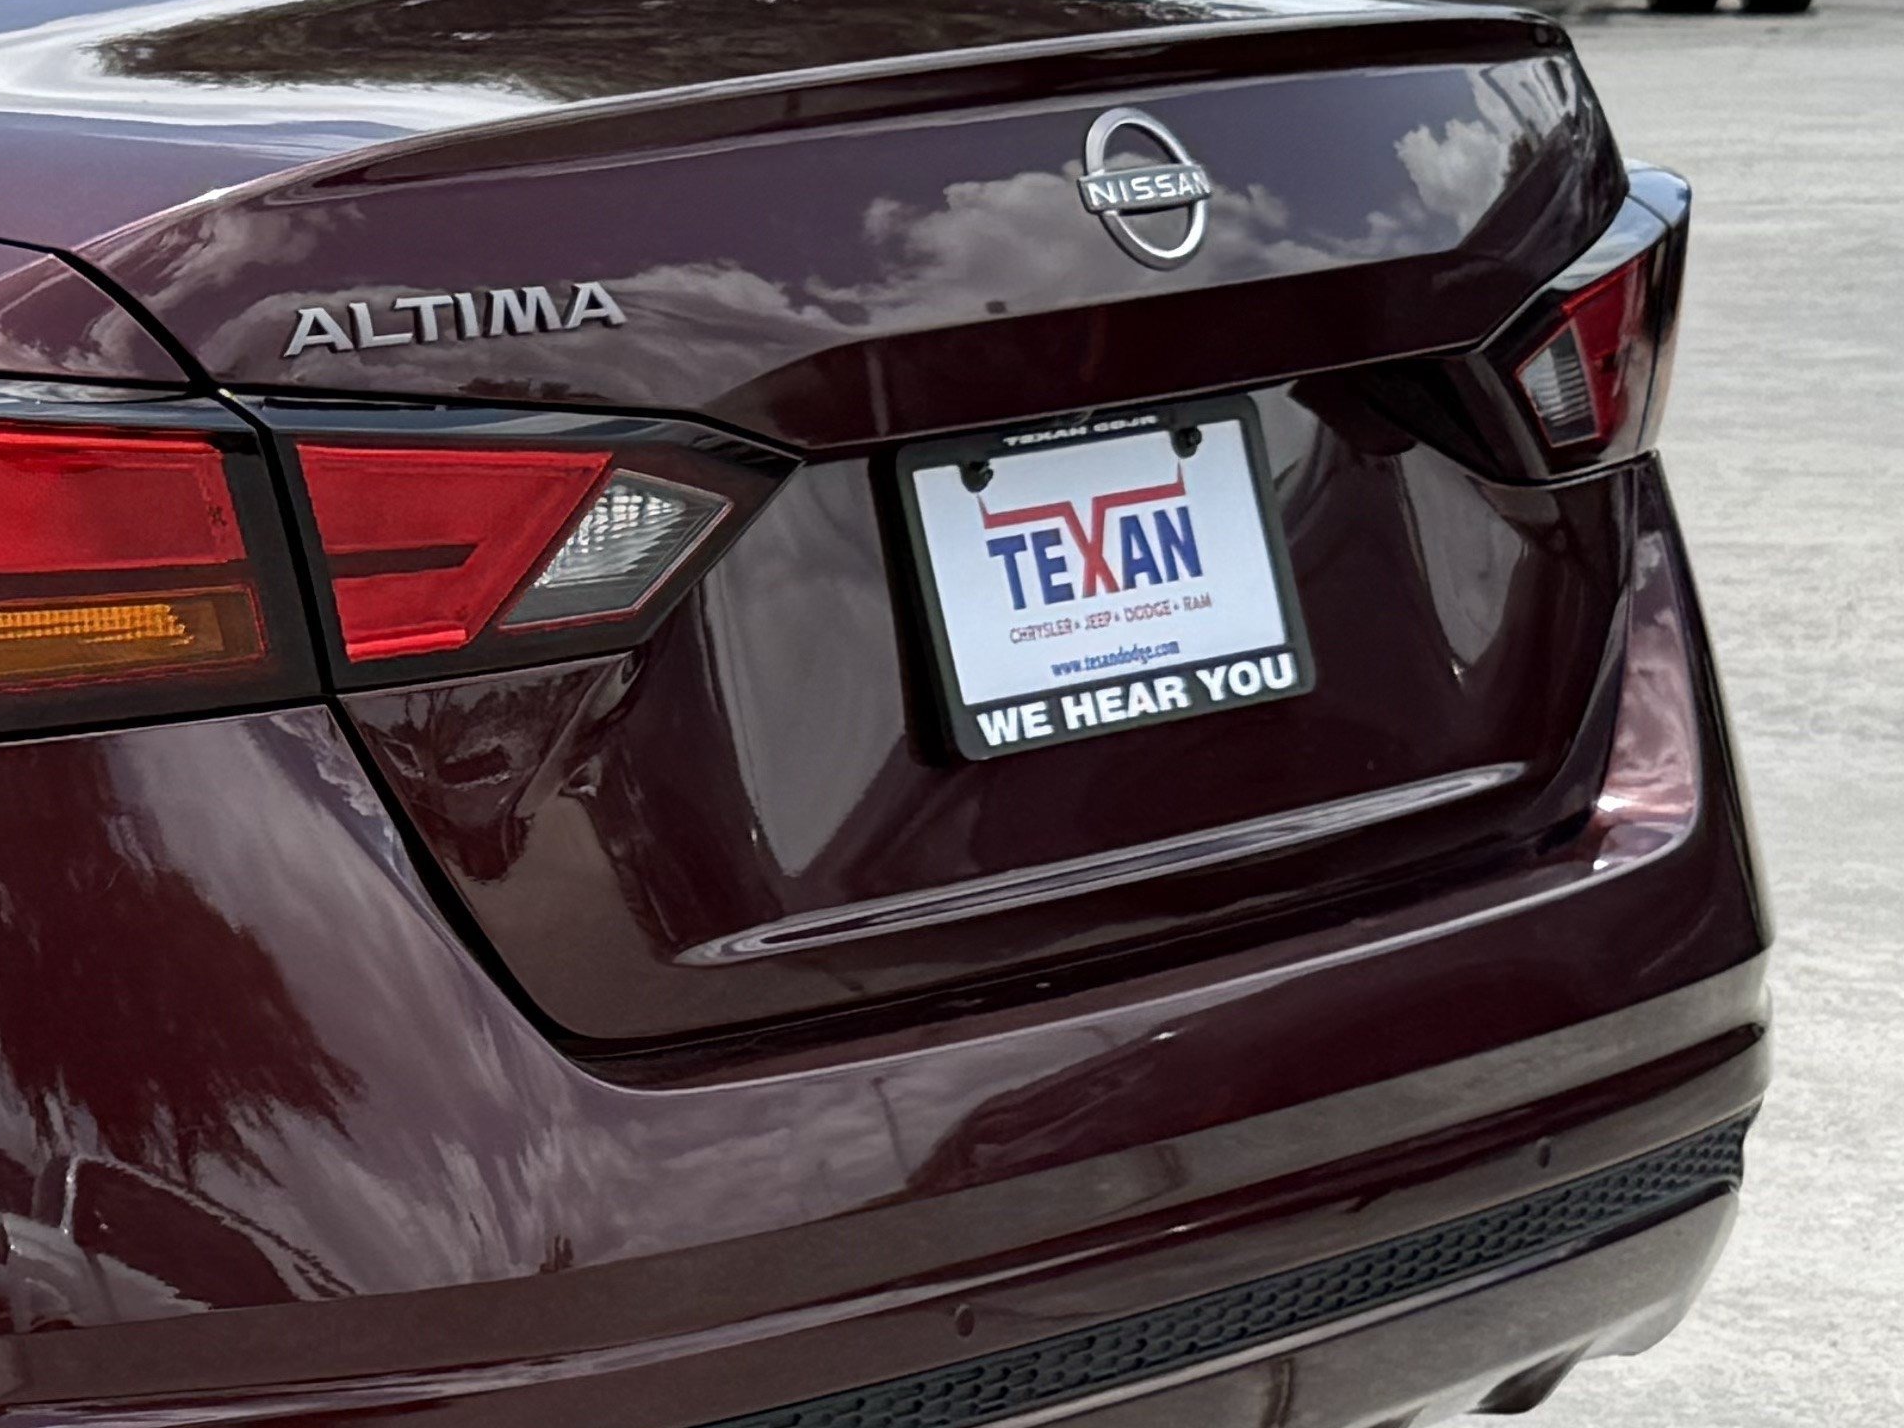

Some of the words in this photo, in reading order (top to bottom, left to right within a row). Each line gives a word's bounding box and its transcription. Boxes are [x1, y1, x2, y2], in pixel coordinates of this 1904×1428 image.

[1086, 171, 1211, 207] NISSAN
[283, 281, 628, 358] ALTIMA
[981, 480, 1204, 610] TEXAN
[1009, 618, 1073, 644] CHRYSLER
[1085, 610, 1112, 630] JEEP
[1124, 599, 1172, 623] DODGE
[1182, 592, 1213, 612] RAM
[976, 700, 1055, 747] WE
[1060, 675, 1193, 730] HEAR
[1196, 651, 1297, 702] YOU
